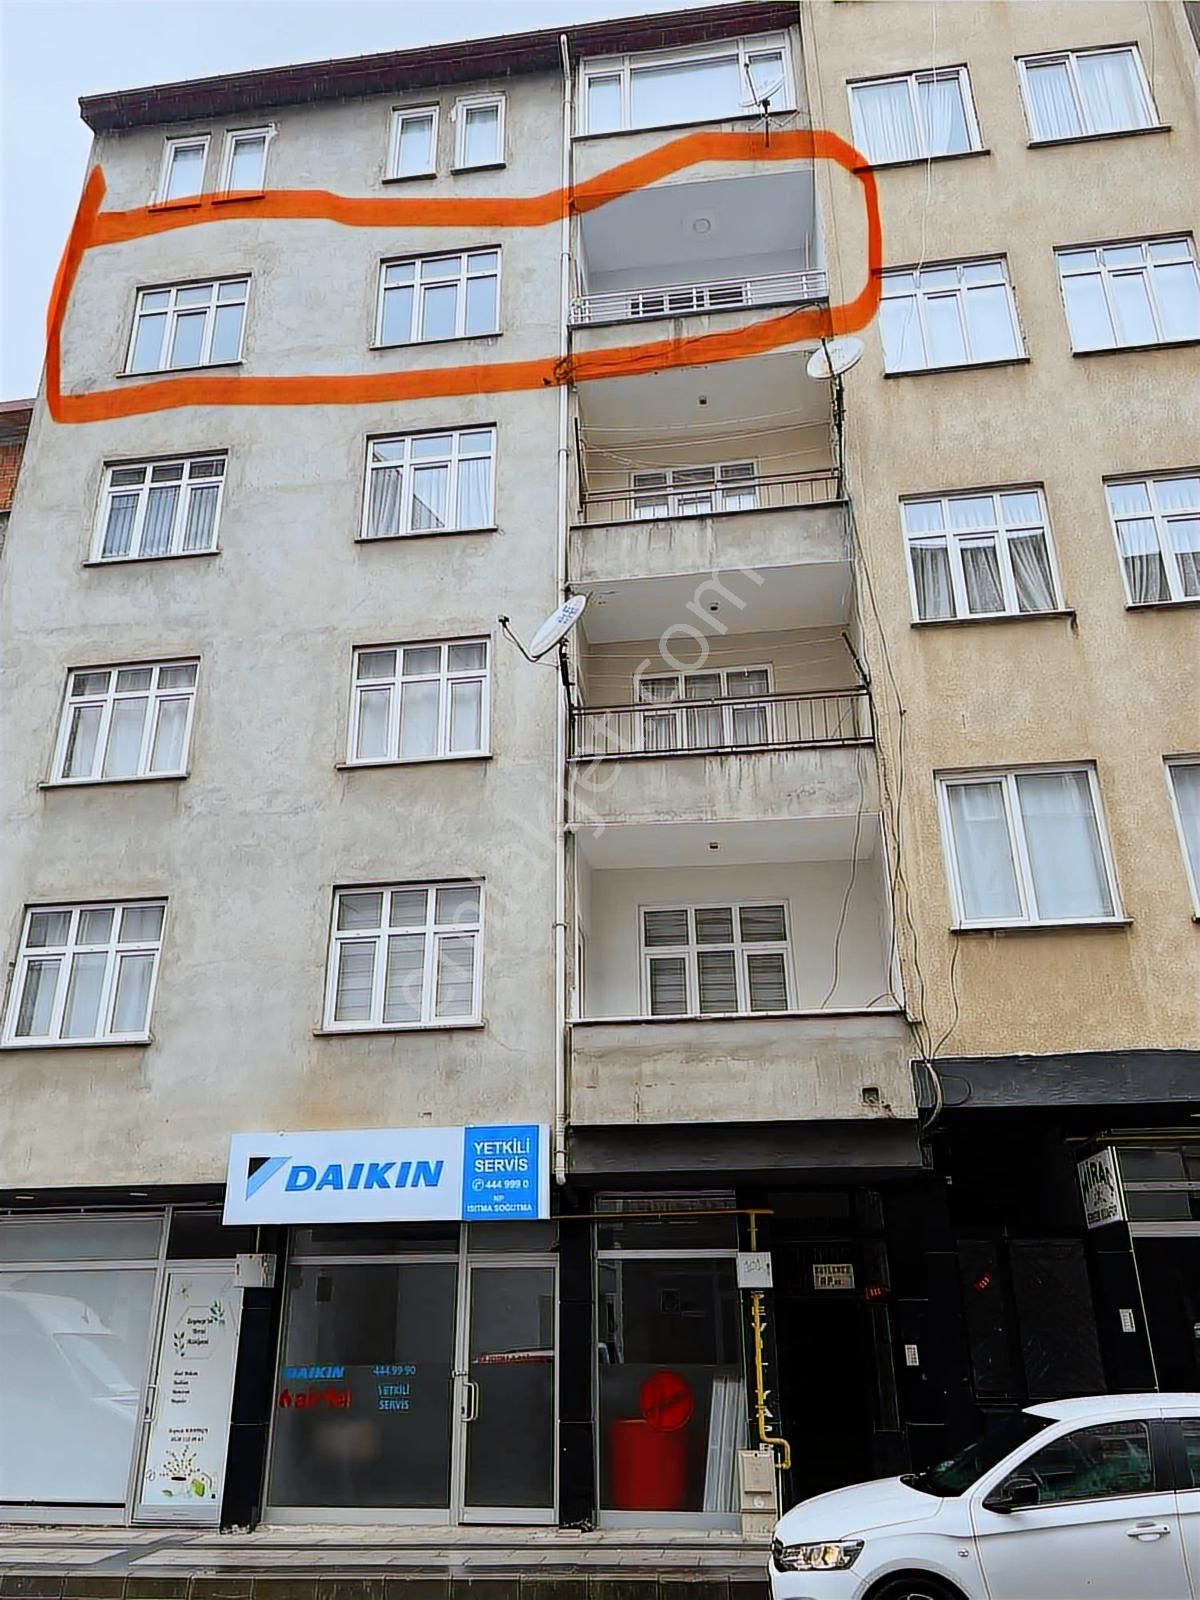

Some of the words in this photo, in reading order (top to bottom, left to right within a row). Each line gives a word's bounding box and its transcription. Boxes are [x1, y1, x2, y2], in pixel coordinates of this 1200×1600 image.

[473, 1137, 530, 1155] YETKİLİ
[474, 1155, 529, 1173] SERVİS
[284, 1159, 444, 1193] DAIKIN
[485, 1179, 502, 1189] 444
[284, 1365, 345, 1379] DAIKIN
